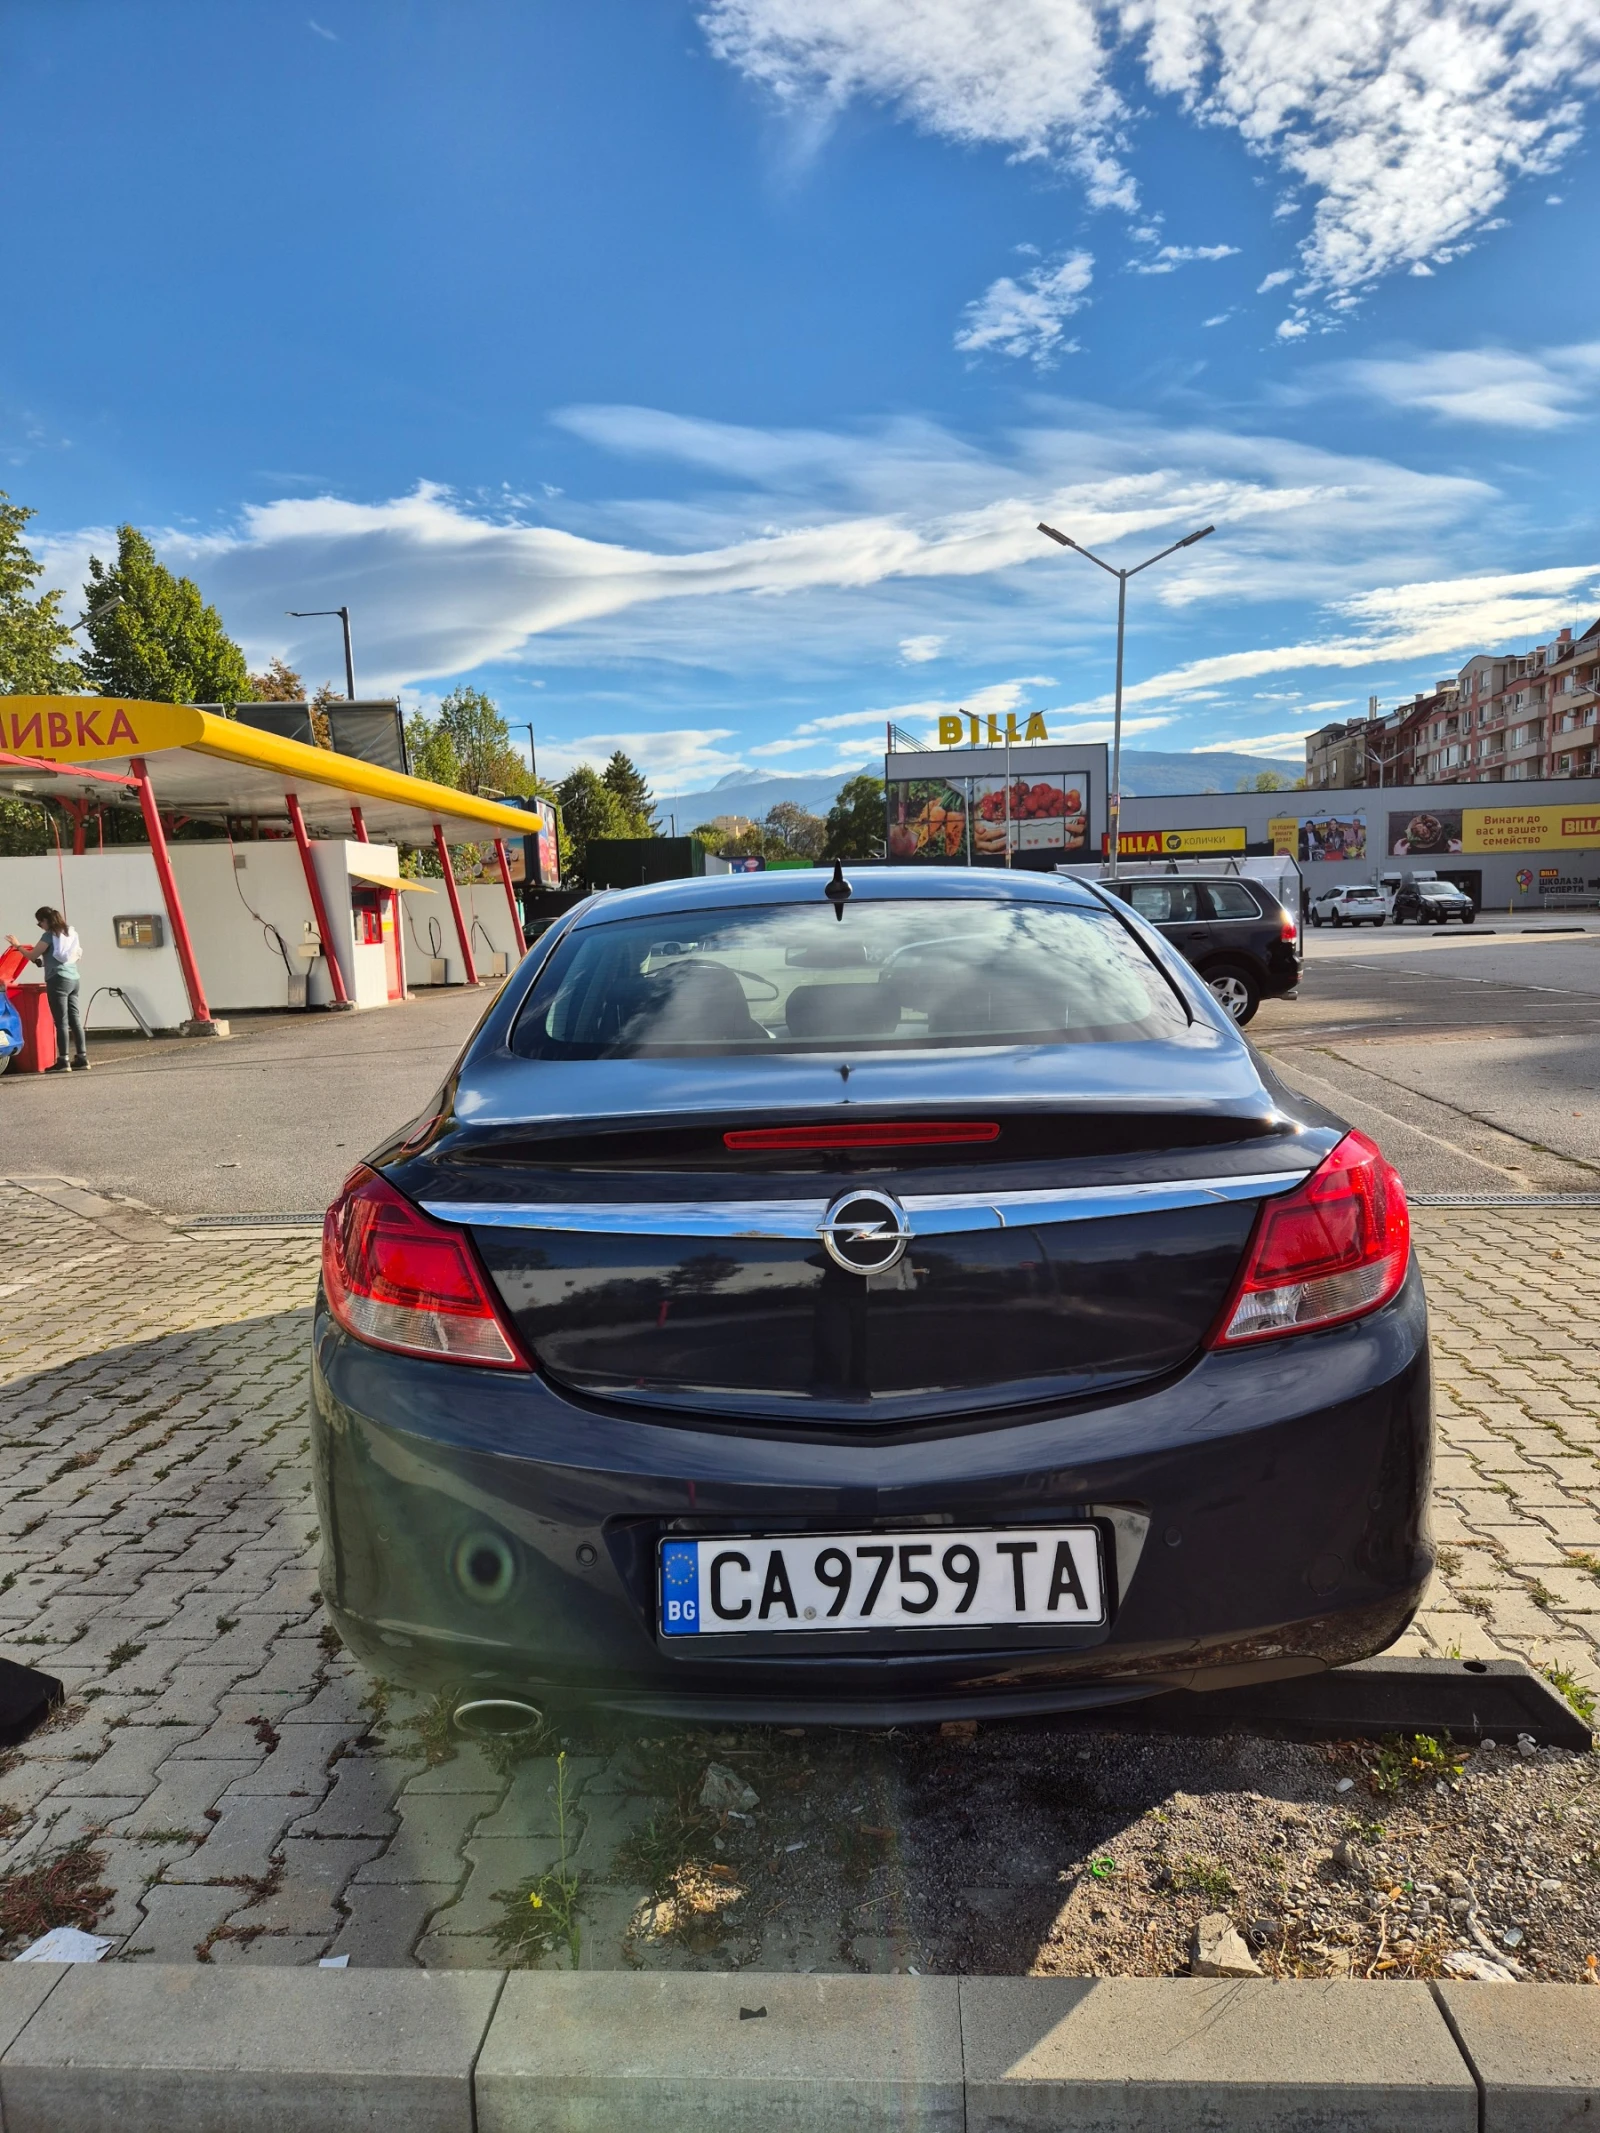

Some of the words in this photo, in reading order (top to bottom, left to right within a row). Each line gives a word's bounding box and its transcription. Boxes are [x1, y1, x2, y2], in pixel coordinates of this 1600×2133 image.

[939, 712, 1049, 745] BILLA
[1484, 815, 1523, 825] Винаги
[1526, 815, 1541, 825] до
[1476, 828, 1494, 836] вас
[1497, 827, 1504, 835] и
[1507, 825, 1548, 834] вашето
[1184, 836, 1226, 846] КОЛИЧКИ
[1483, 836, 1541, 845] семейство
[1539, 877, 1572, 886] ШКОЛА
[1572, 877, 1584, 885] ЗА
[1539, 886, 1584, 894] ЕКСПЕРТИ
[709, 1550, 798, 1620] CA
[813, 1544, 979, 1618] 9759
[996, 1540, 1089, 1612] TA
[667, 1601, 696, 1621] BG
